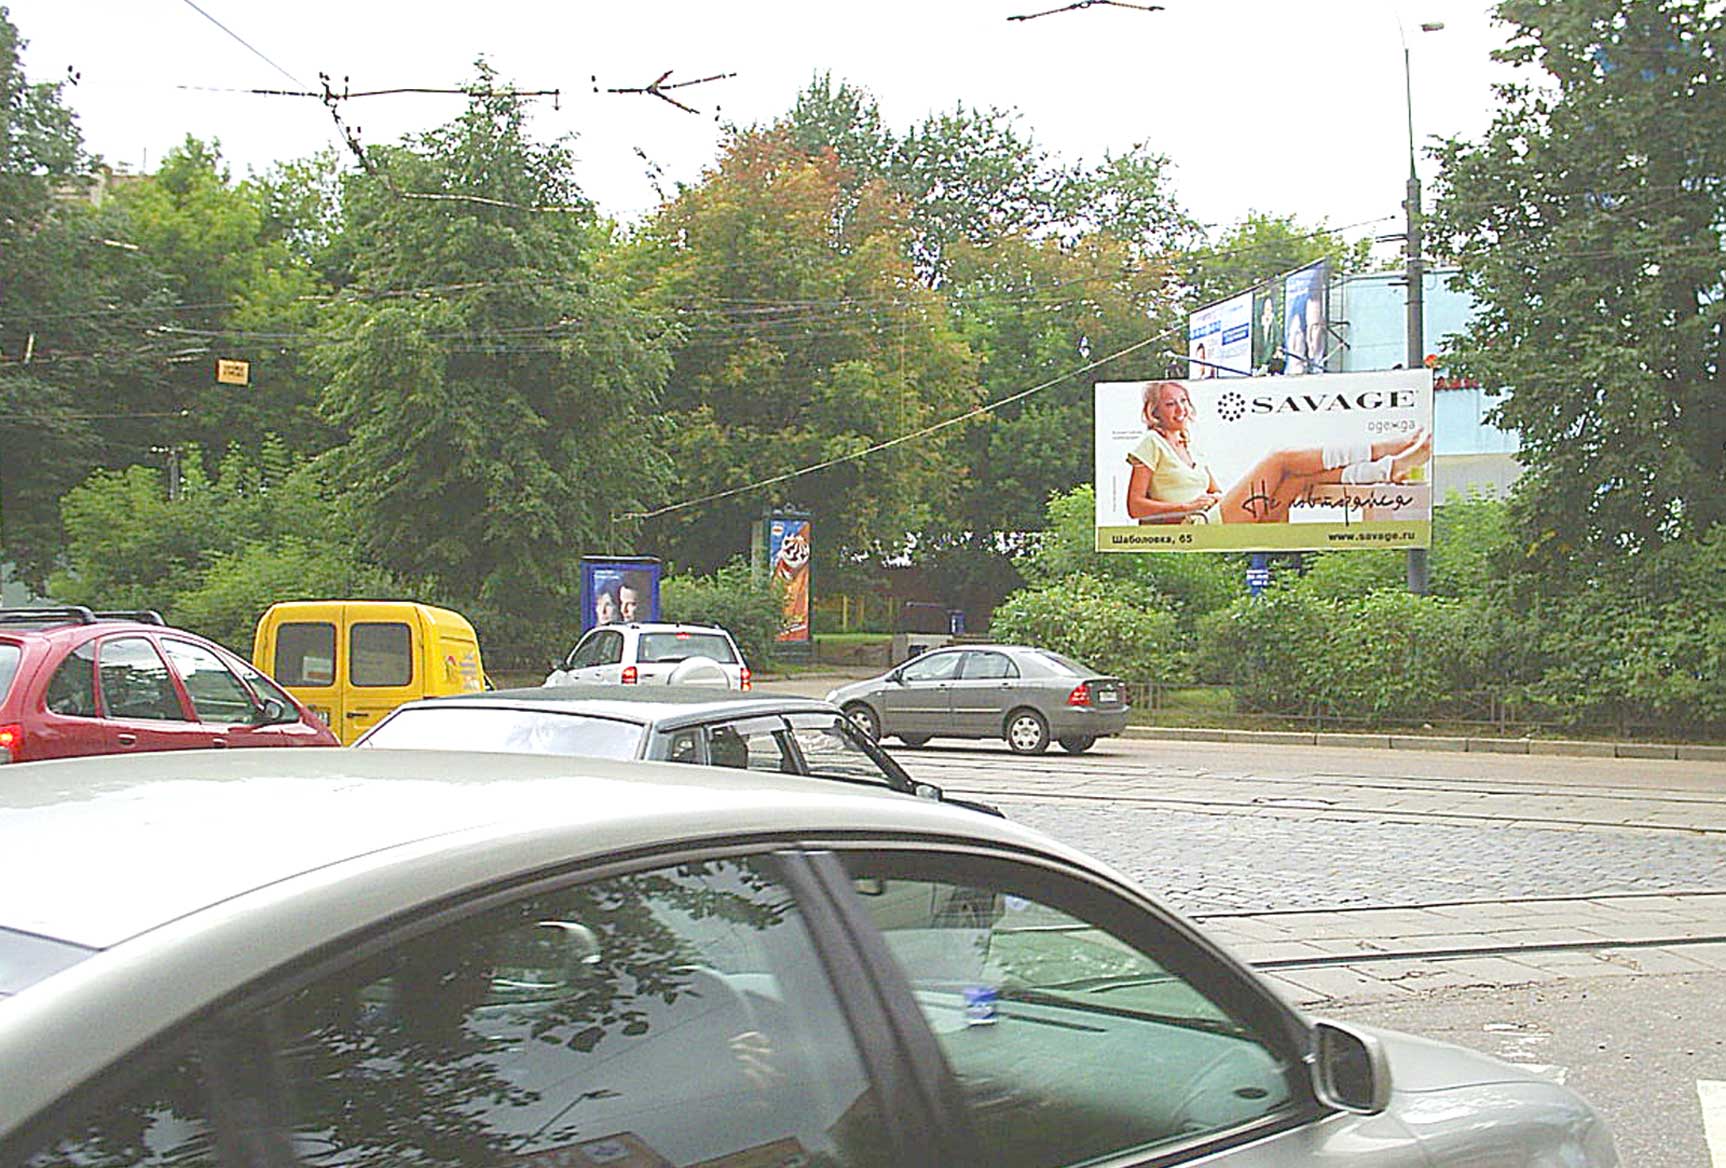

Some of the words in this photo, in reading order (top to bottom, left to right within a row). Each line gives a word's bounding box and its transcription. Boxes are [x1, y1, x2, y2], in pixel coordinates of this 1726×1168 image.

[1251, 389, 1415, 414] SAVAGE
[1178, 533, 1193, 544] 65
[1327, 531, 1416, 543] www.savage.ru
